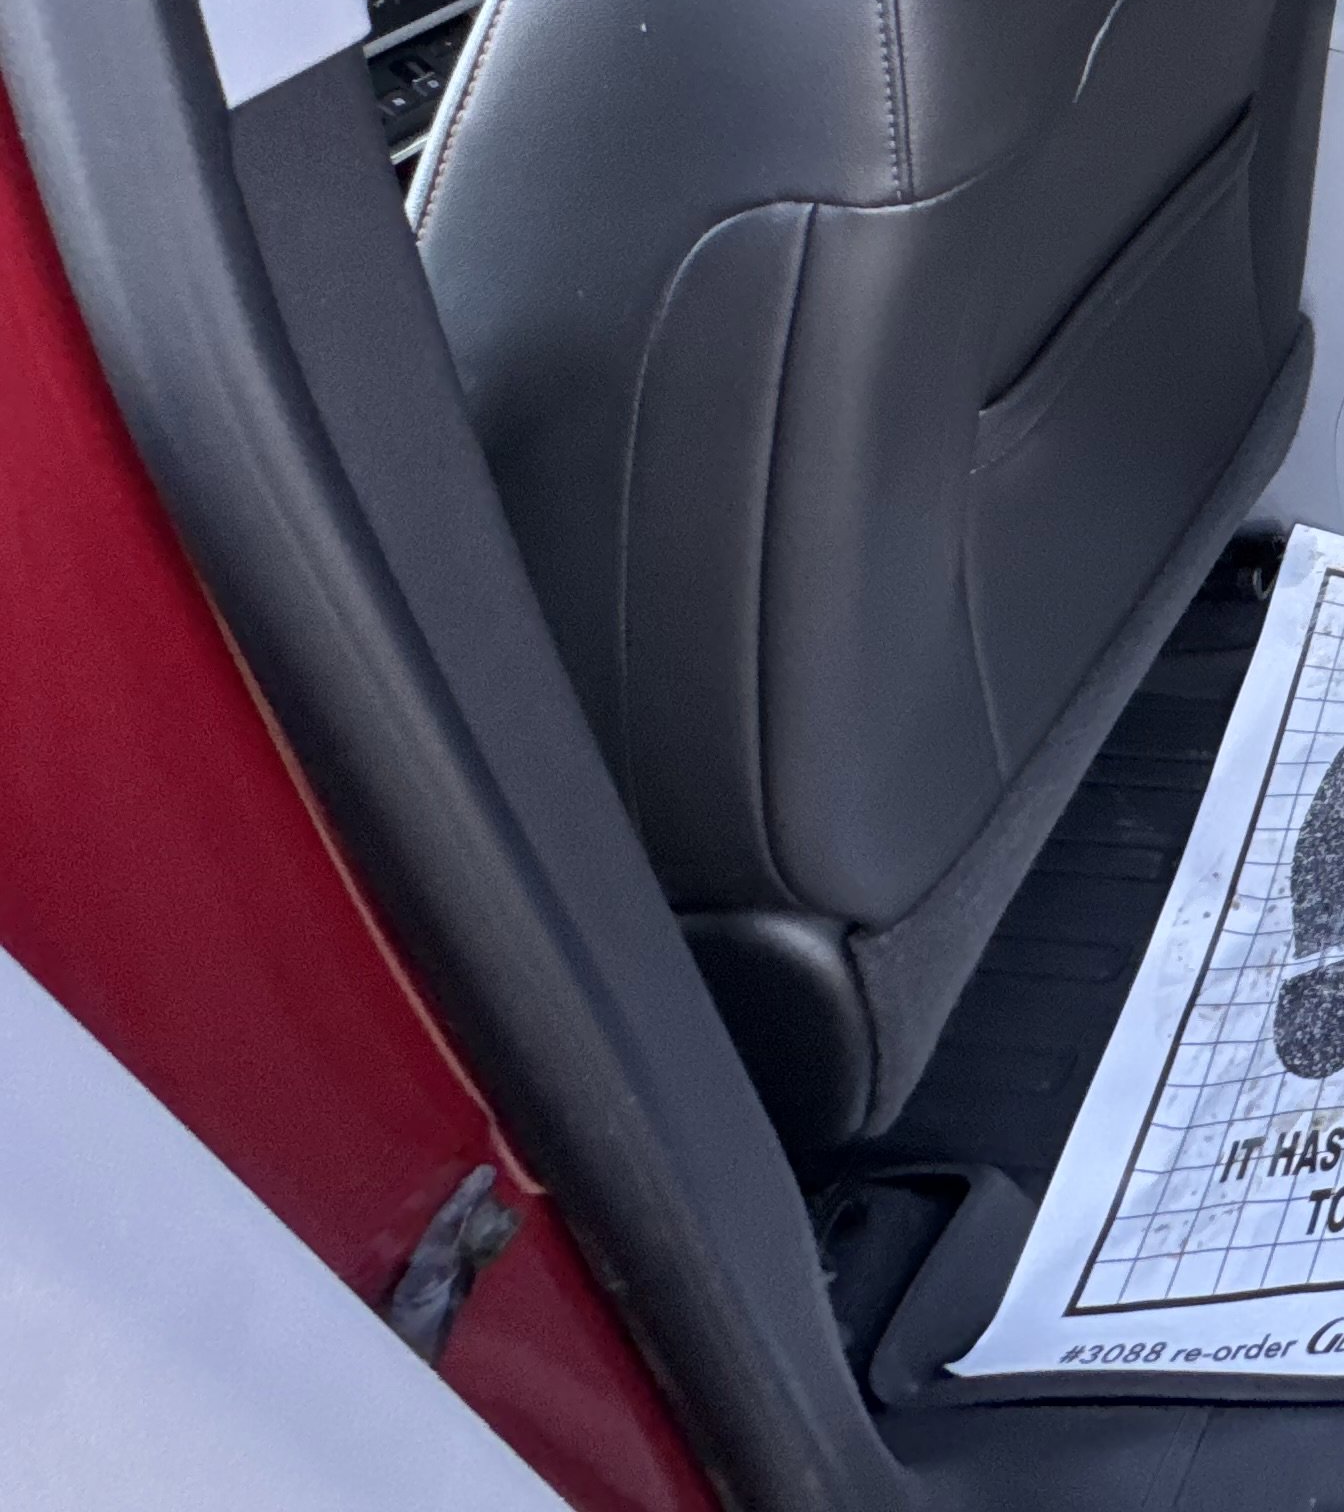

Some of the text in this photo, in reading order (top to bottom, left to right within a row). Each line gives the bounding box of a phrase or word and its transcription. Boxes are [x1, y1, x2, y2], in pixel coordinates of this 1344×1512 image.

[1220, 1135, 1266, 1183] IT
[1059, 1341, 1168, 1365] #3088
[1169, 1333, 1298, 1363] re-order
